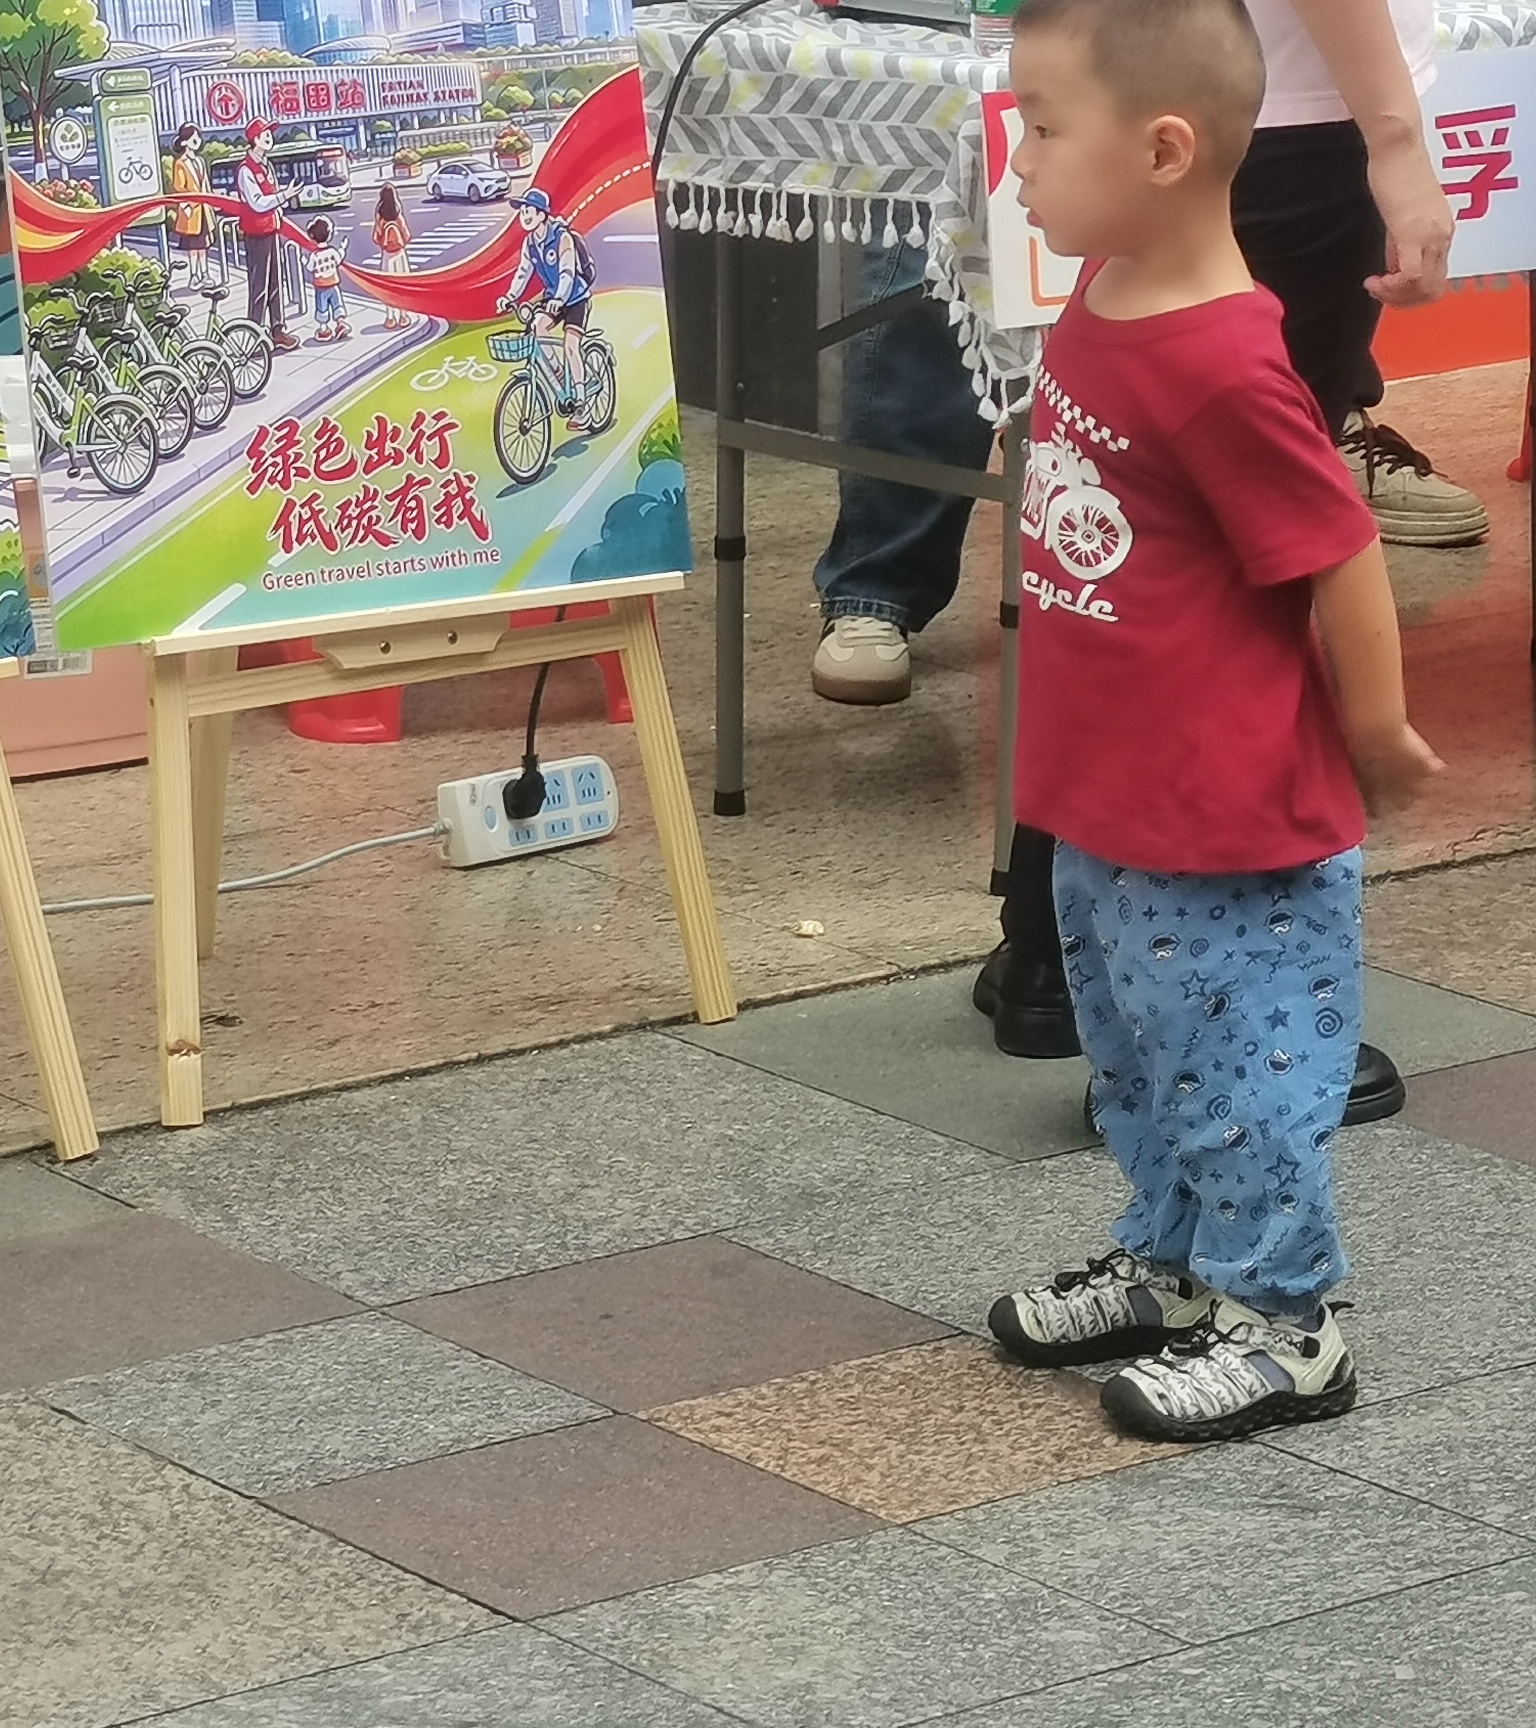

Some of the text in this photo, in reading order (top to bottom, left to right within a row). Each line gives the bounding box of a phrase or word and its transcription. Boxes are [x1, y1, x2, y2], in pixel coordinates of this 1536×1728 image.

[270, 78, 367, 115] 福田站
[245, 410, 460, 496] 绿色出行
[269, 472, 490, 555] 低碳有我
[263, 547, 500, 591] Green travel starts with me
